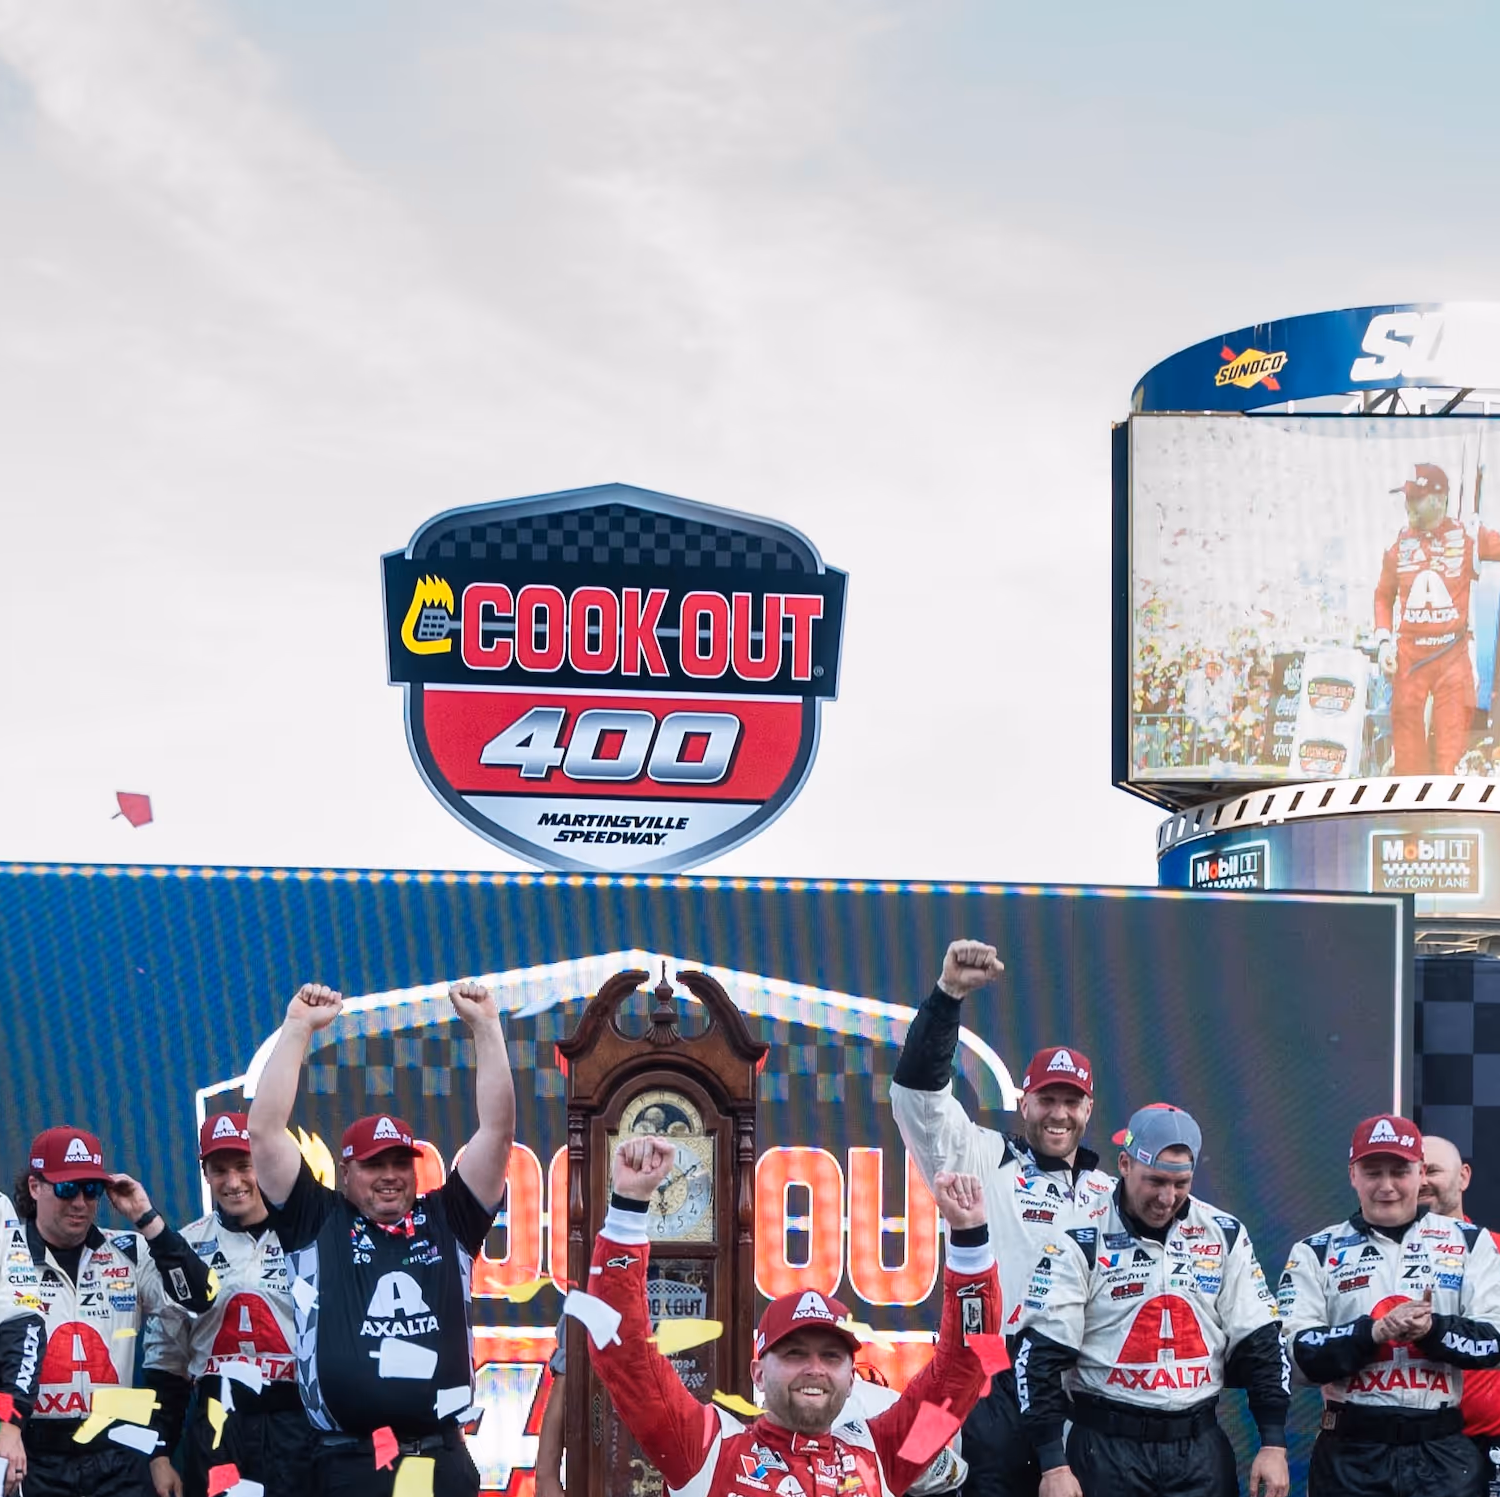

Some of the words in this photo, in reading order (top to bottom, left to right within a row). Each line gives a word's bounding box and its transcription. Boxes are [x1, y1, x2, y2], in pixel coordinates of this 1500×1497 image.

[1217, 350, 1285, 384] SUNOCO
[462, 582, 670, 677] COOK
[680, 591, 825, 682] OUT
[480, 706, 742, 784] 400
[537, 812, 690, 831] MARTINSVILLE
[553, 829, 667, 846] SPEEDWAY
[1382, 839, 1445, 862] Mobil
[1197, 856, 1238, 881] Mobil
[1383, 877, 1435, 890] VICTORY
[1440, 876, 1470, 889] LANE
[1047, 1063, 1077, 1073] AXALTA
[373, 1131, 402, 1140] AXALTA
[1368, 1135, 1399, 1145] AXALTA
[1400, 1135, 1415, 1148] 24
[64, 1154, 93, 1163] AXALTA
[1131, 1259, 1157, 1268] AXALTA
[1106, 1271, 1150, 1284] GOODYEAR
[791, 1309, 834, 1320] AXALTA
[359, 1316, 441, 1337] AXALTA
[1441, 1331, 1500, 1357] AXALTA
[14, 1324, 42, 1394] AXALTA
[1014, 1337, 1033, 1414] AXALTA
[1106, 1366, 1212, 1391] AXALTA
[1346, 1368, 1451, 1395] AXALTA
[735, 1474, 770, 1491] Valvoline
